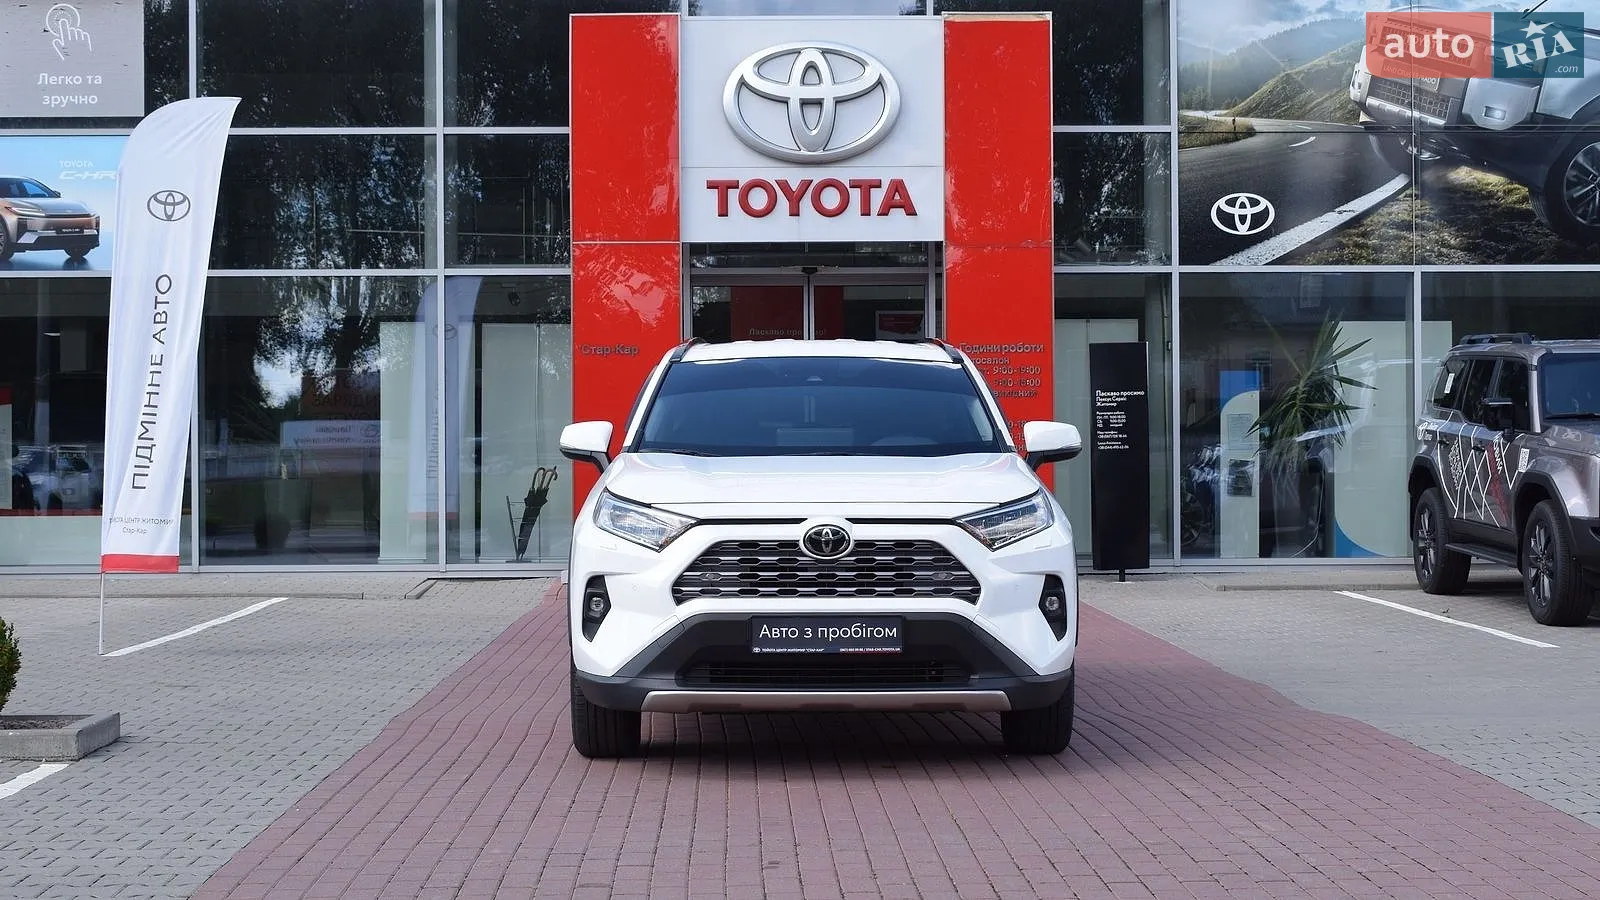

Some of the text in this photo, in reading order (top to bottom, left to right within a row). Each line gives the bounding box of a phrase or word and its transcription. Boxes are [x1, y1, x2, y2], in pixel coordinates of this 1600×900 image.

[37, 73, 102, 85] Легко та
[42, 94, 98, 107] зручно
[59, 160, 94, 168] TOYOTA
[706, 178, 918, 218] TOYOTA
[1002, 342, 1045, 354] роботи
[131, 274, 172, 490] ПІДМІННЕ АВТО
[759, 623, 897, 642] Авто з пробігом
